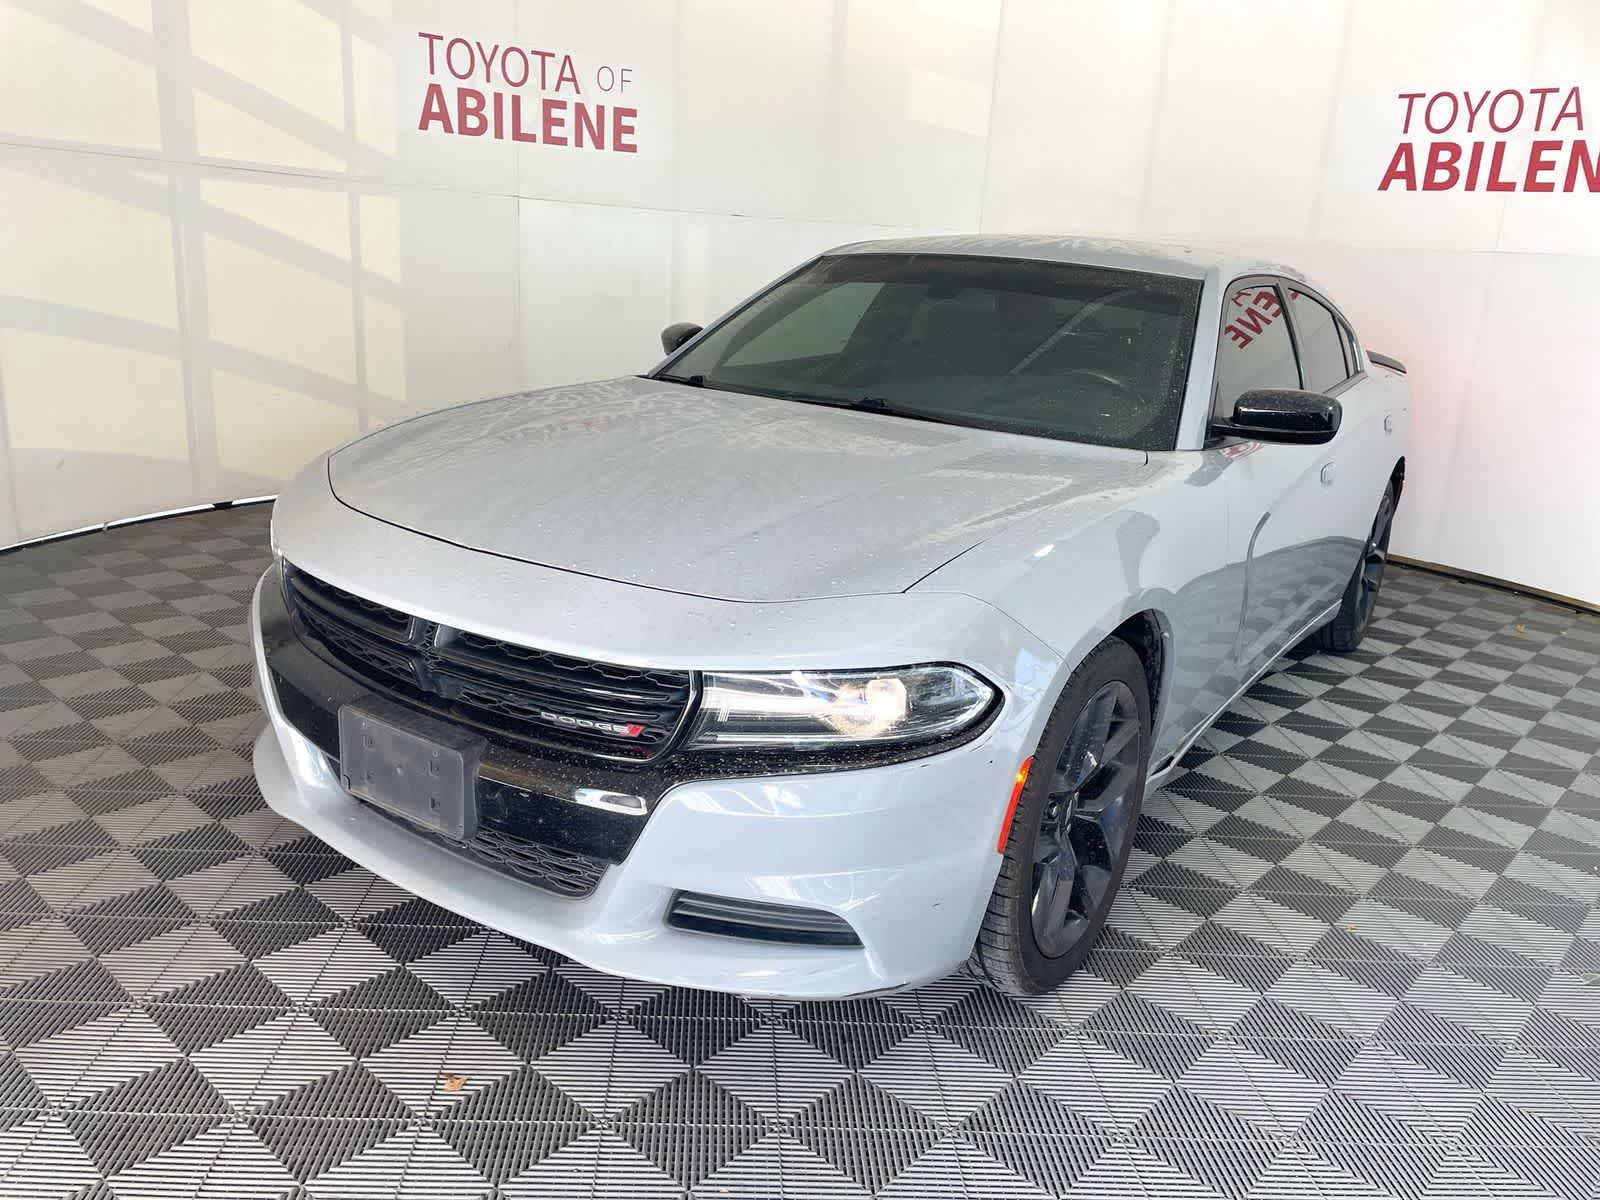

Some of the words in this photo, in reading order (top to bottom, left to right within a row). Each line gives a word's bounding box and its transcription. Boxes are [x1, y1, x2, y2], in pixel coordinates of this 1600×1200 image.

[418, 31, 581, 95] TOYOTA
[596, 65, 633, 93] OF
[418, 82, 638, 153] ABILENE
[1398, 86, 1584, 134] TOYOTA
[541, 711, 629, 736] DODGE
